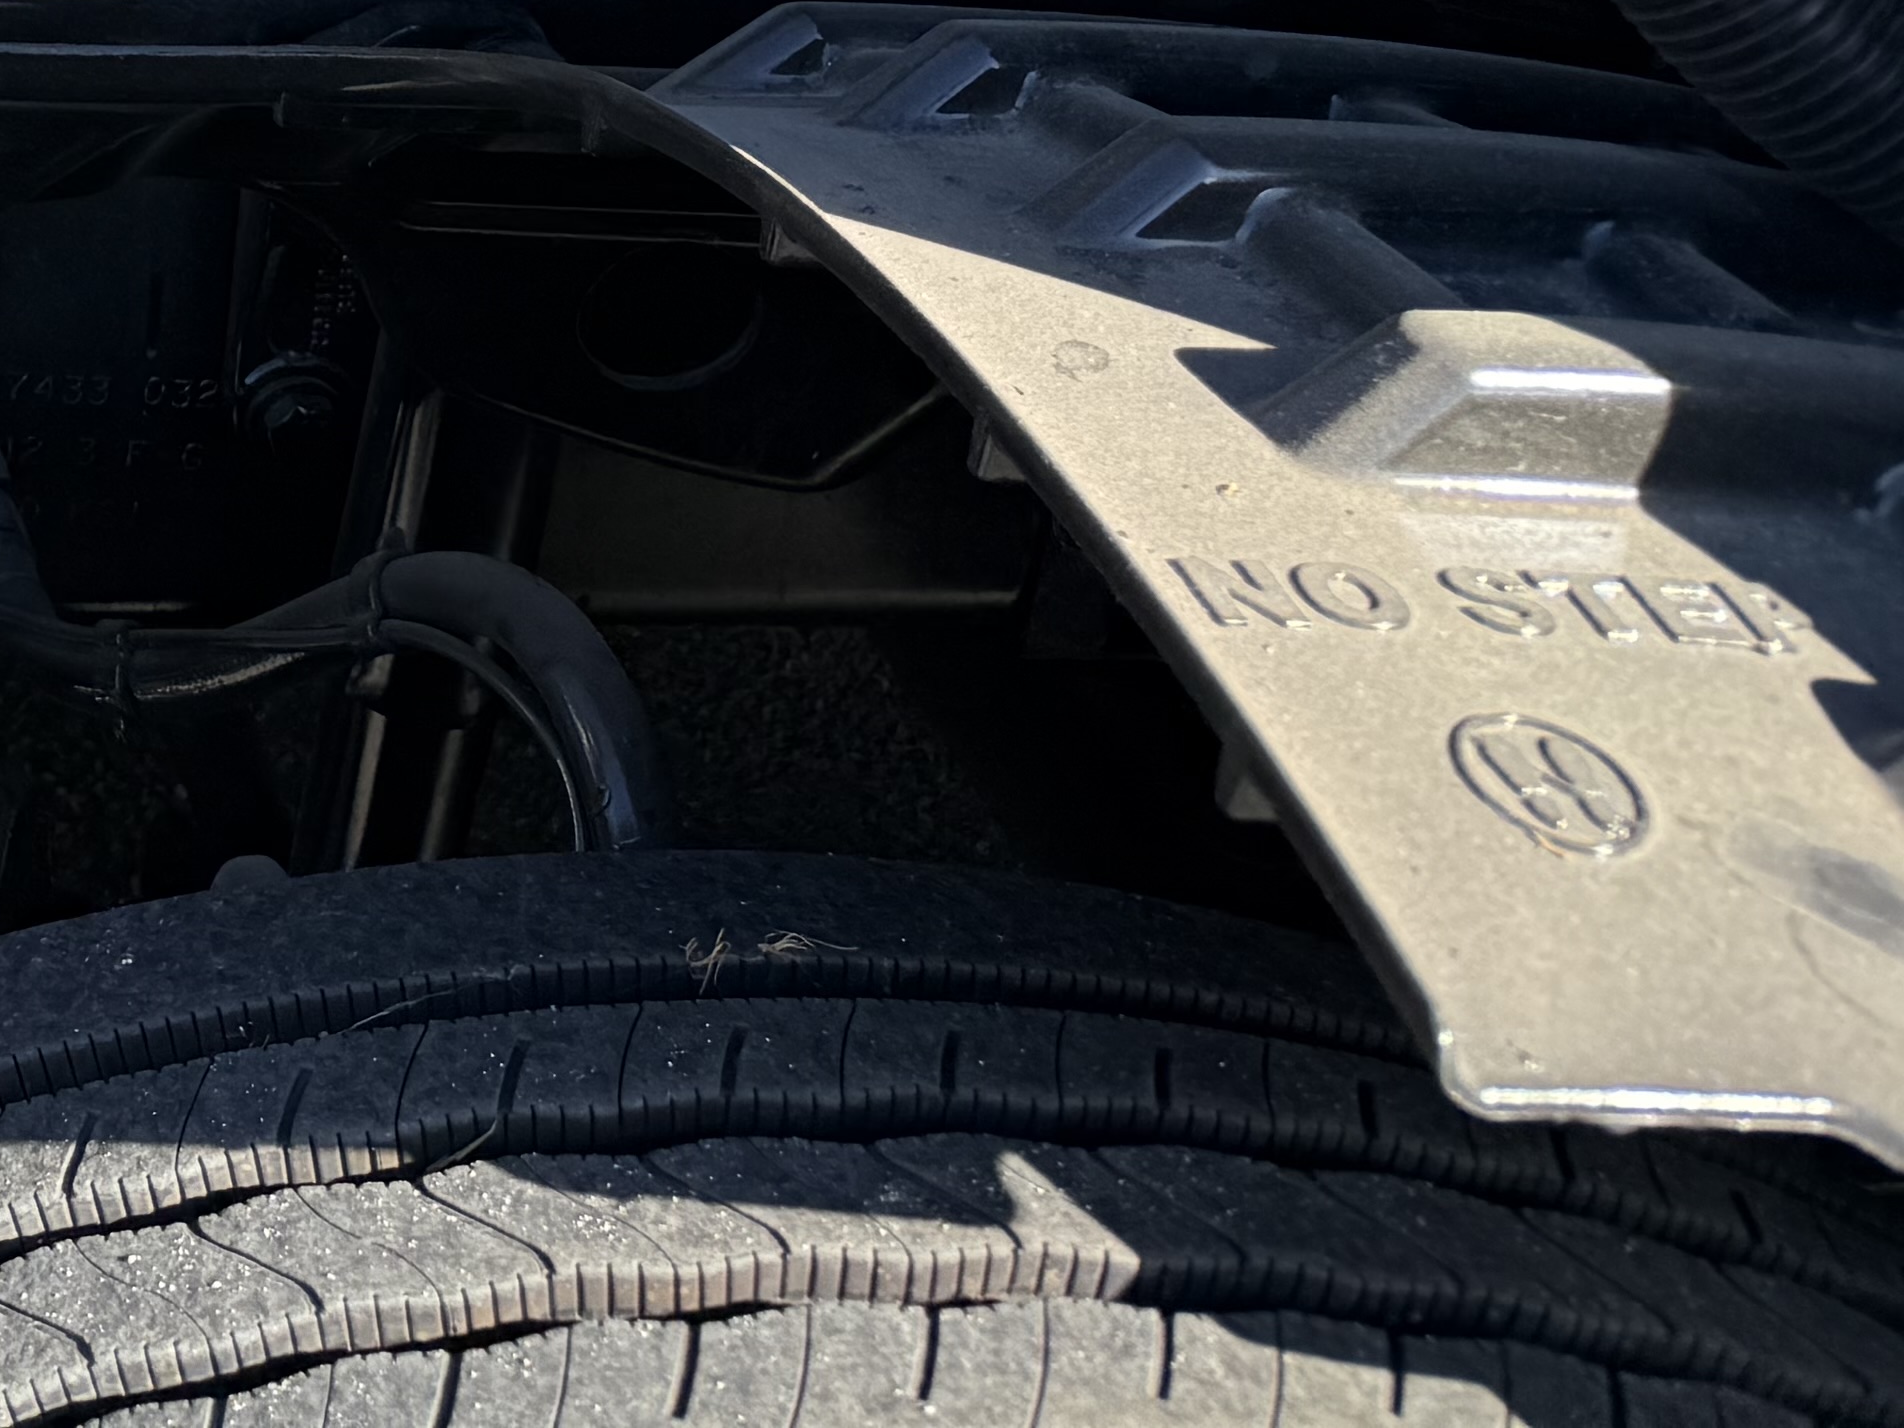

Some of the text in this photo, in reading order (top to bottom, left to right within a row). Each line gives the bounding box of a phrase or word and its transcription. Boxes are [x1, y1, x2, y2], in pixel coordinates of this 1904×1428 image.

[144, 375, 219, 408] 032
[1165, 555, 1816, 657] NO STEP
